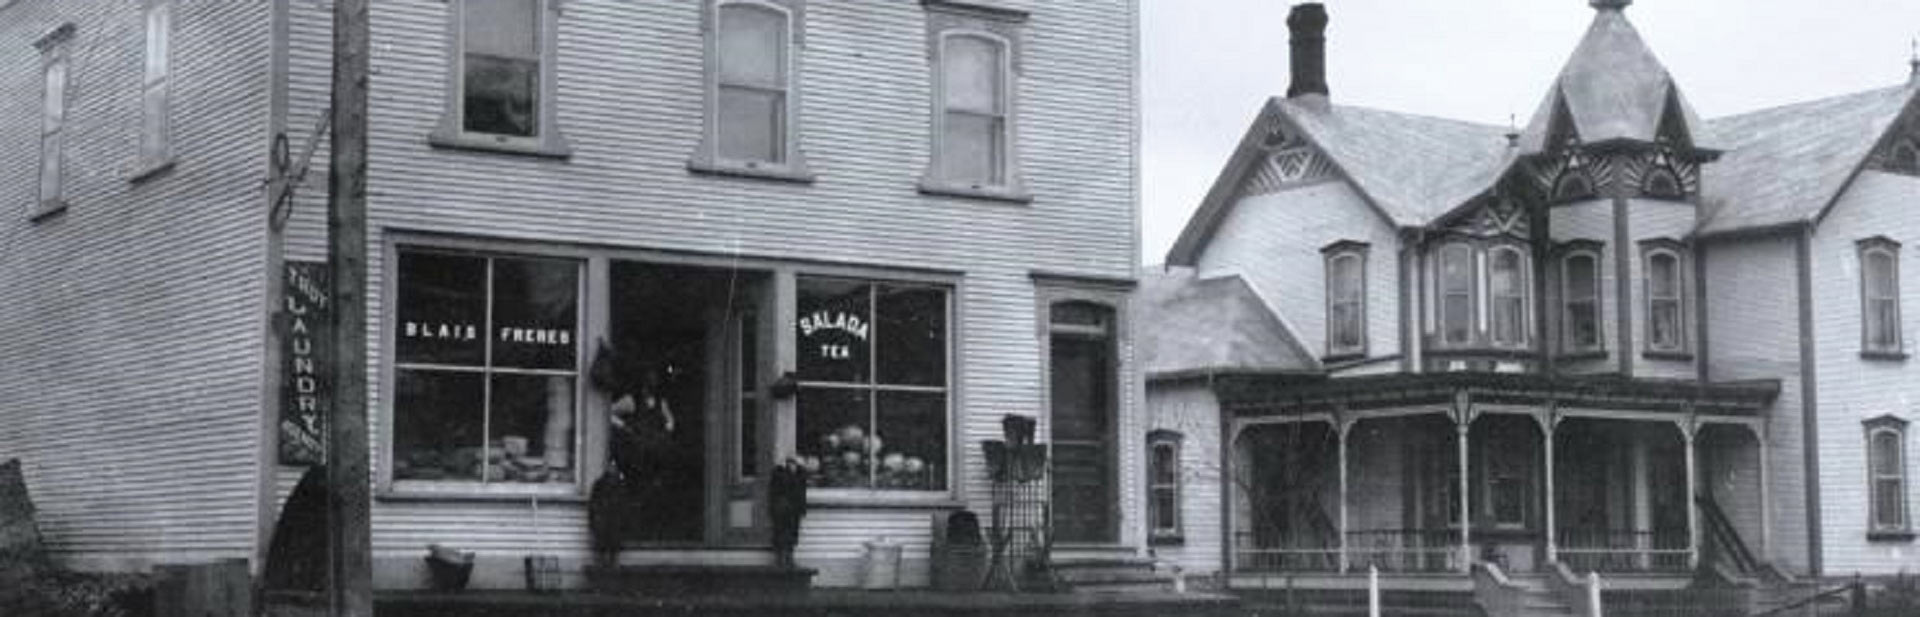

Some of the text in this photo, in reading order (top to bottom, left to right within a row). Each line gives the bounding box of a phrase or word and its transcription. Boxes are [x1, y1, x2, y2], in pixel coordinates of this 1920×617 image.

[405, 321, 569, 344] BLAIS FRERES
[799, 309, 869, 340] SALADA
[288, 296, 320, 435] LAUNDRY
[820, 344, 849, 360] TEA
